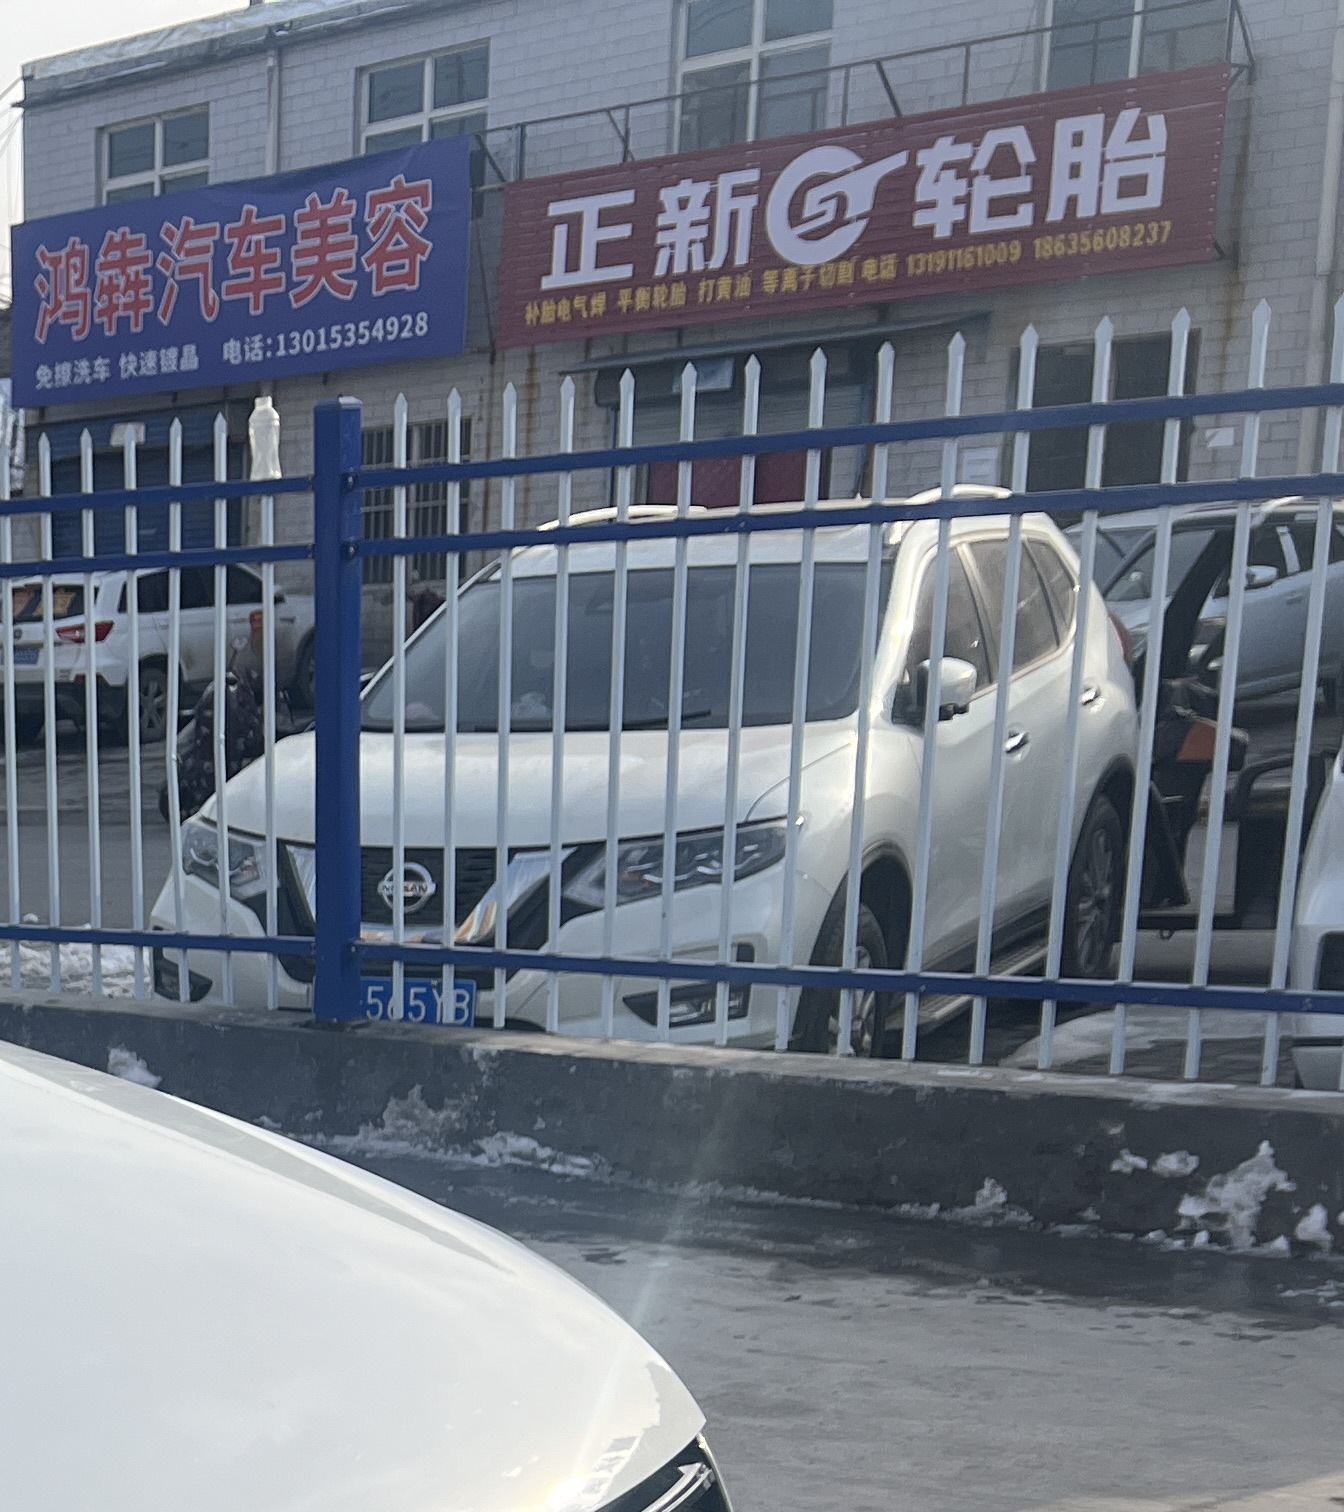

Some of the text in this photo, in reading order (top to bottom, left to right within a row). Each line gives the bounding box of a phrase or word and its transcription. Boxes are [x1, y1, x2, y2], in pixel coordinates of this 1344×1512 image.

[33, 174, 432, 344] 鸿犇汽车美容
[539, 168, 760, 290] 正新
[912, 107, 1168, 238] 轮胎
[1033, 219, 1174, 260] 18635608237
